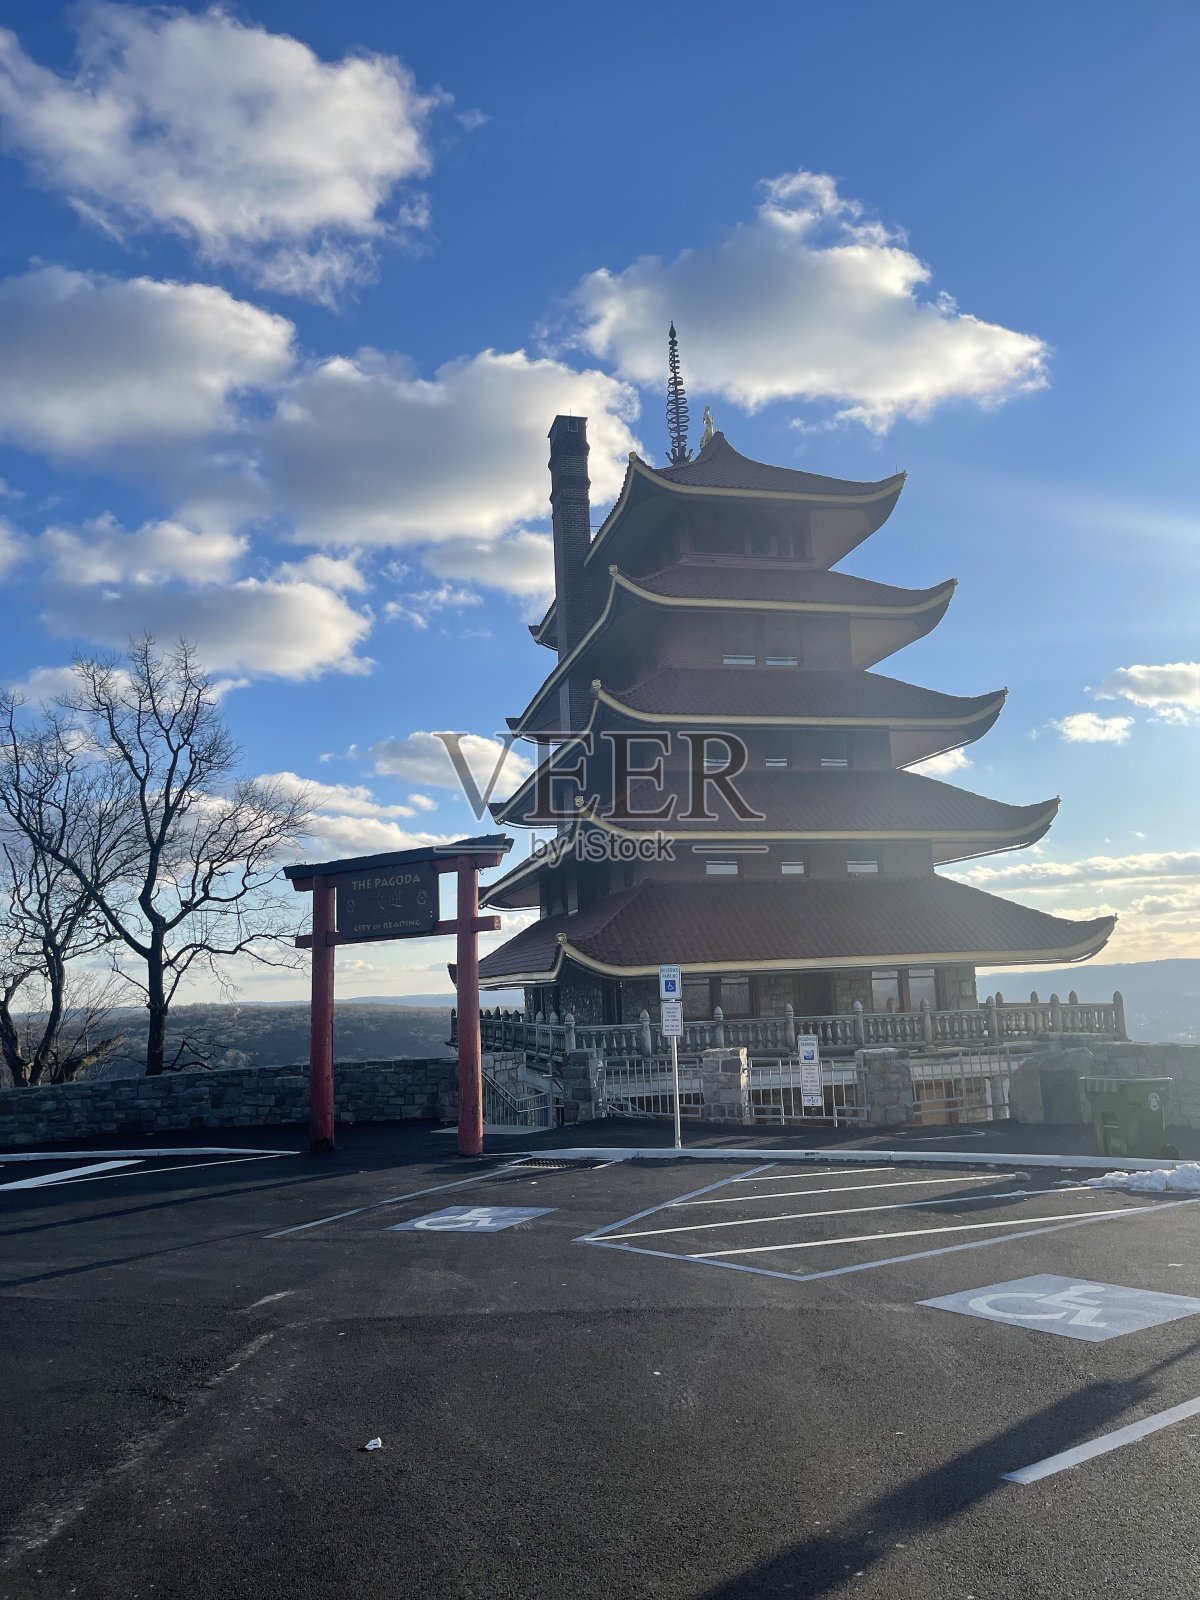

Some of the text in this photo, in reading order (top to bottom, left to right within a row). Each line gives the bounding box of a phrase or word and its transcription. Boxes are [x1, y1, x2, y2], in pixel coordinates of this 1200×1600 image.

[352, 874, 420, 891] THE PAGODA
[354, 924, 371, 932] CITY
[384, 920, 420, 928] READING
